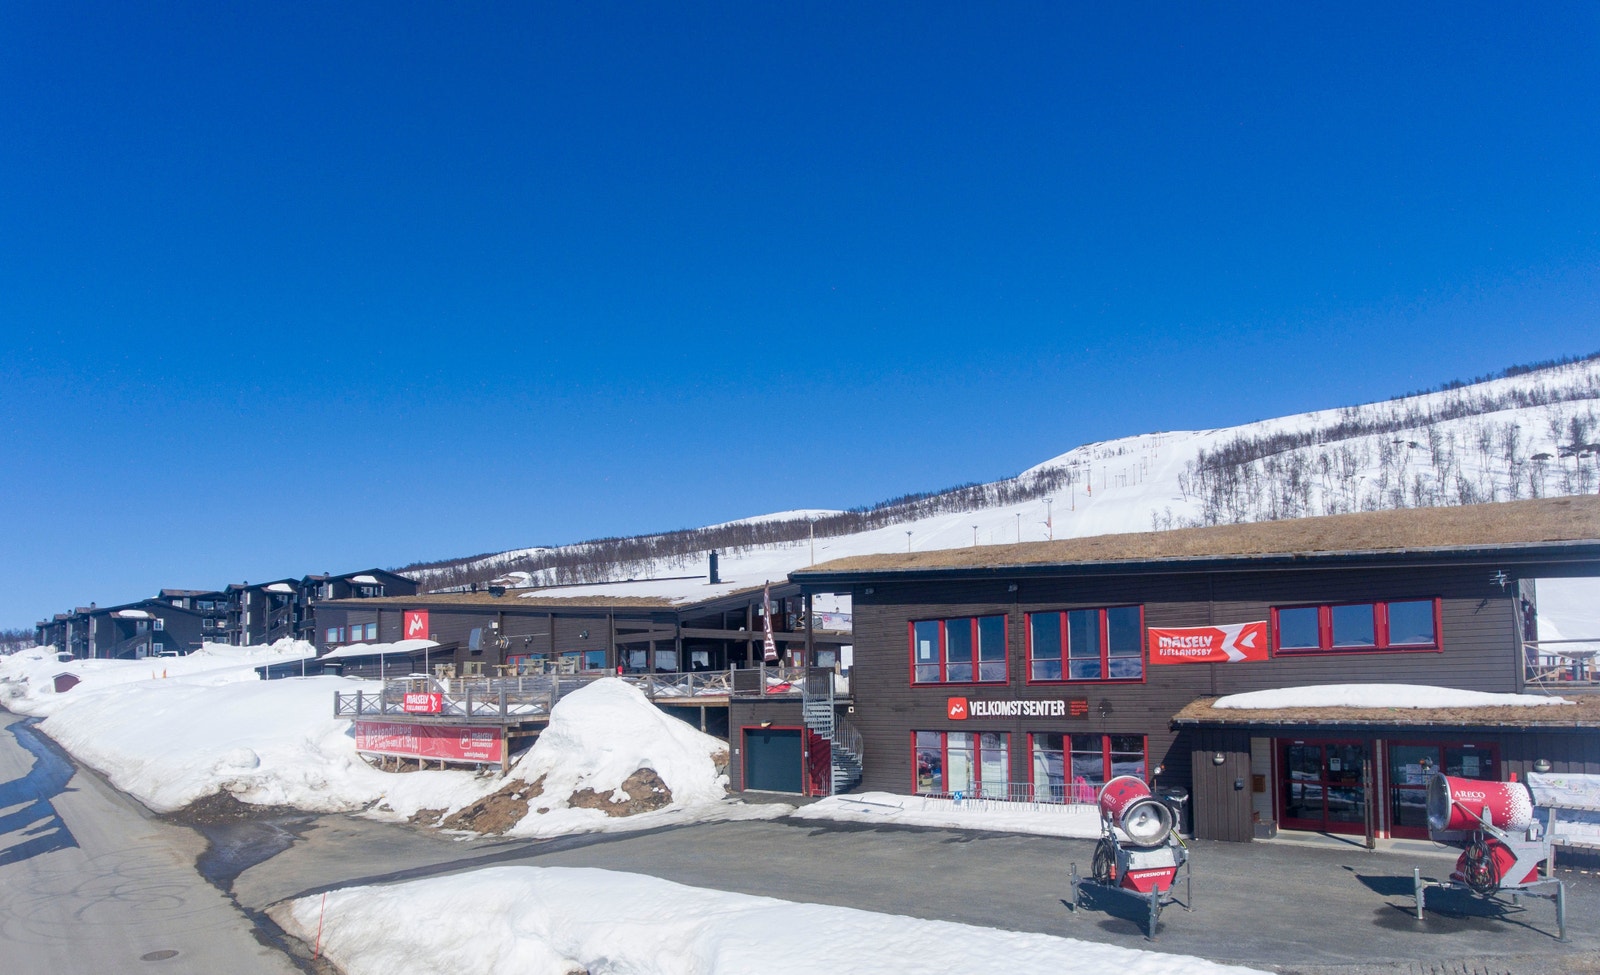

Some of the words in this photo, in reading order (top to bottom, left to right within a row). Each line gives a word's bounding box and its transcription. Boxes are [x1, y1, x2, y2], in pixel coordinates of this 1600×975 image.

[1159, 648, 1213, 657] FJELLANDSBY
[969, 700, 1066, 716] VELKOMSTSENTER
[1454, 790, 1486, 799] ARECO
[1133, 871, 1166, 880] SUPERSNOW
